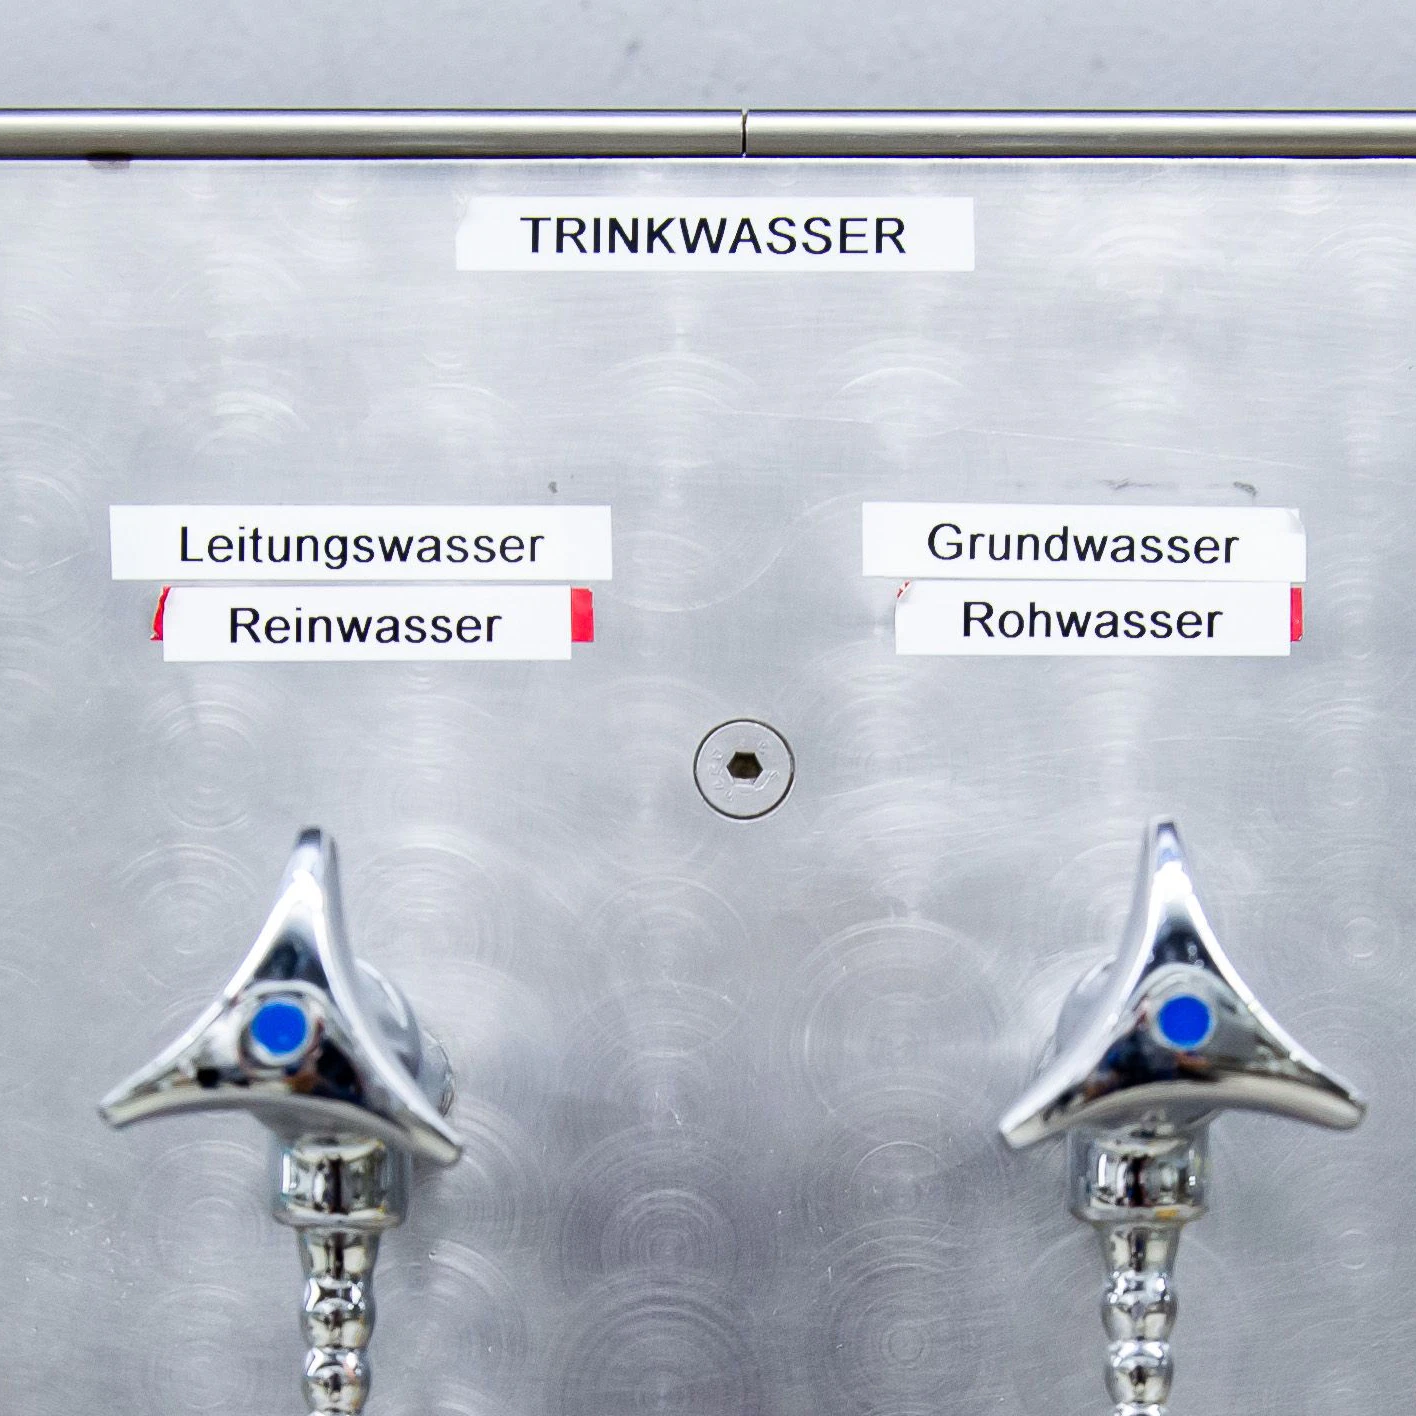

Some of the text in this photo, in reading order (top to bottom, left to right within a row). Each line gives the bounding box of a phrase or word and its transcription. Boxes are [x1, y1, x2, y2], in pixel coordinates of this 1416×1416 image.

[520, 217, 906, 255] TRINKWASSER
[180, 526, 545, 570] Leitungswasser
[927, 523, 1240, 564] Grundwasser
[230, 607, 502, 644] Reinwasser
[963, 601, 1223, 639] Rohwasser
